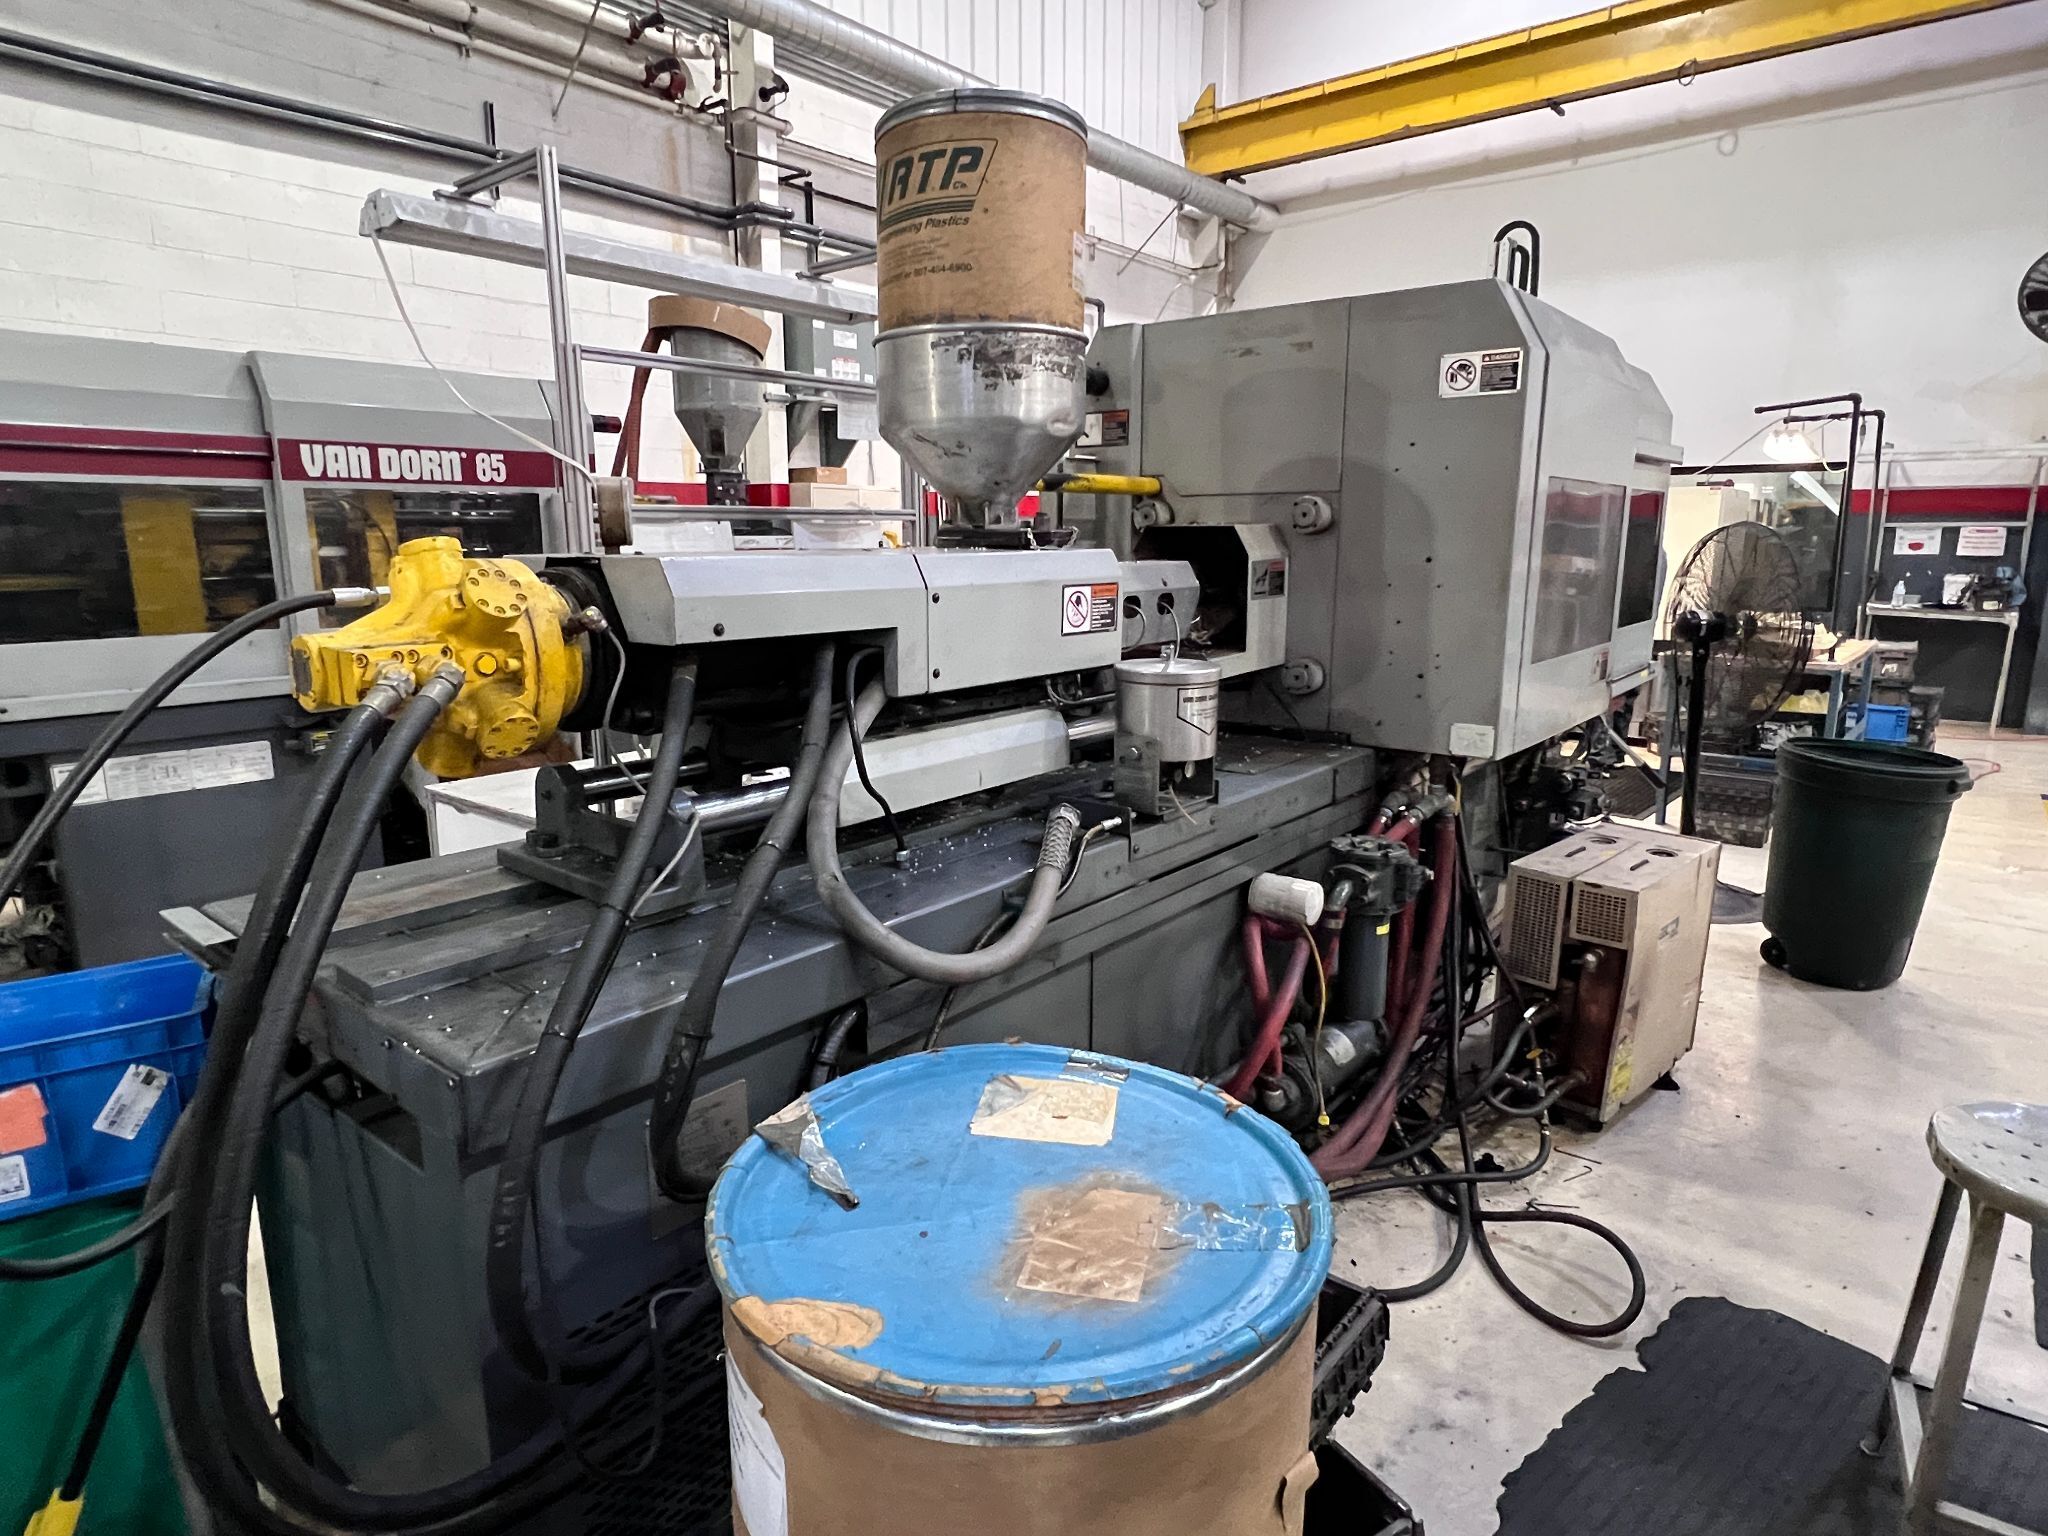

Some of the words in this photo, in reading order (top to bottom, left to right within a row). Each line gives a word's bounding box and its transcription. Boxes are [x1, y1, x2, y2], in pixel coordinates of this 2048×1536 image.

[888, 147, 984, 205] RTP
[924, 215, 970, 230] Plastics
[300, 443, 372, 479] VAN
[475, 452, 507, 483] 85
